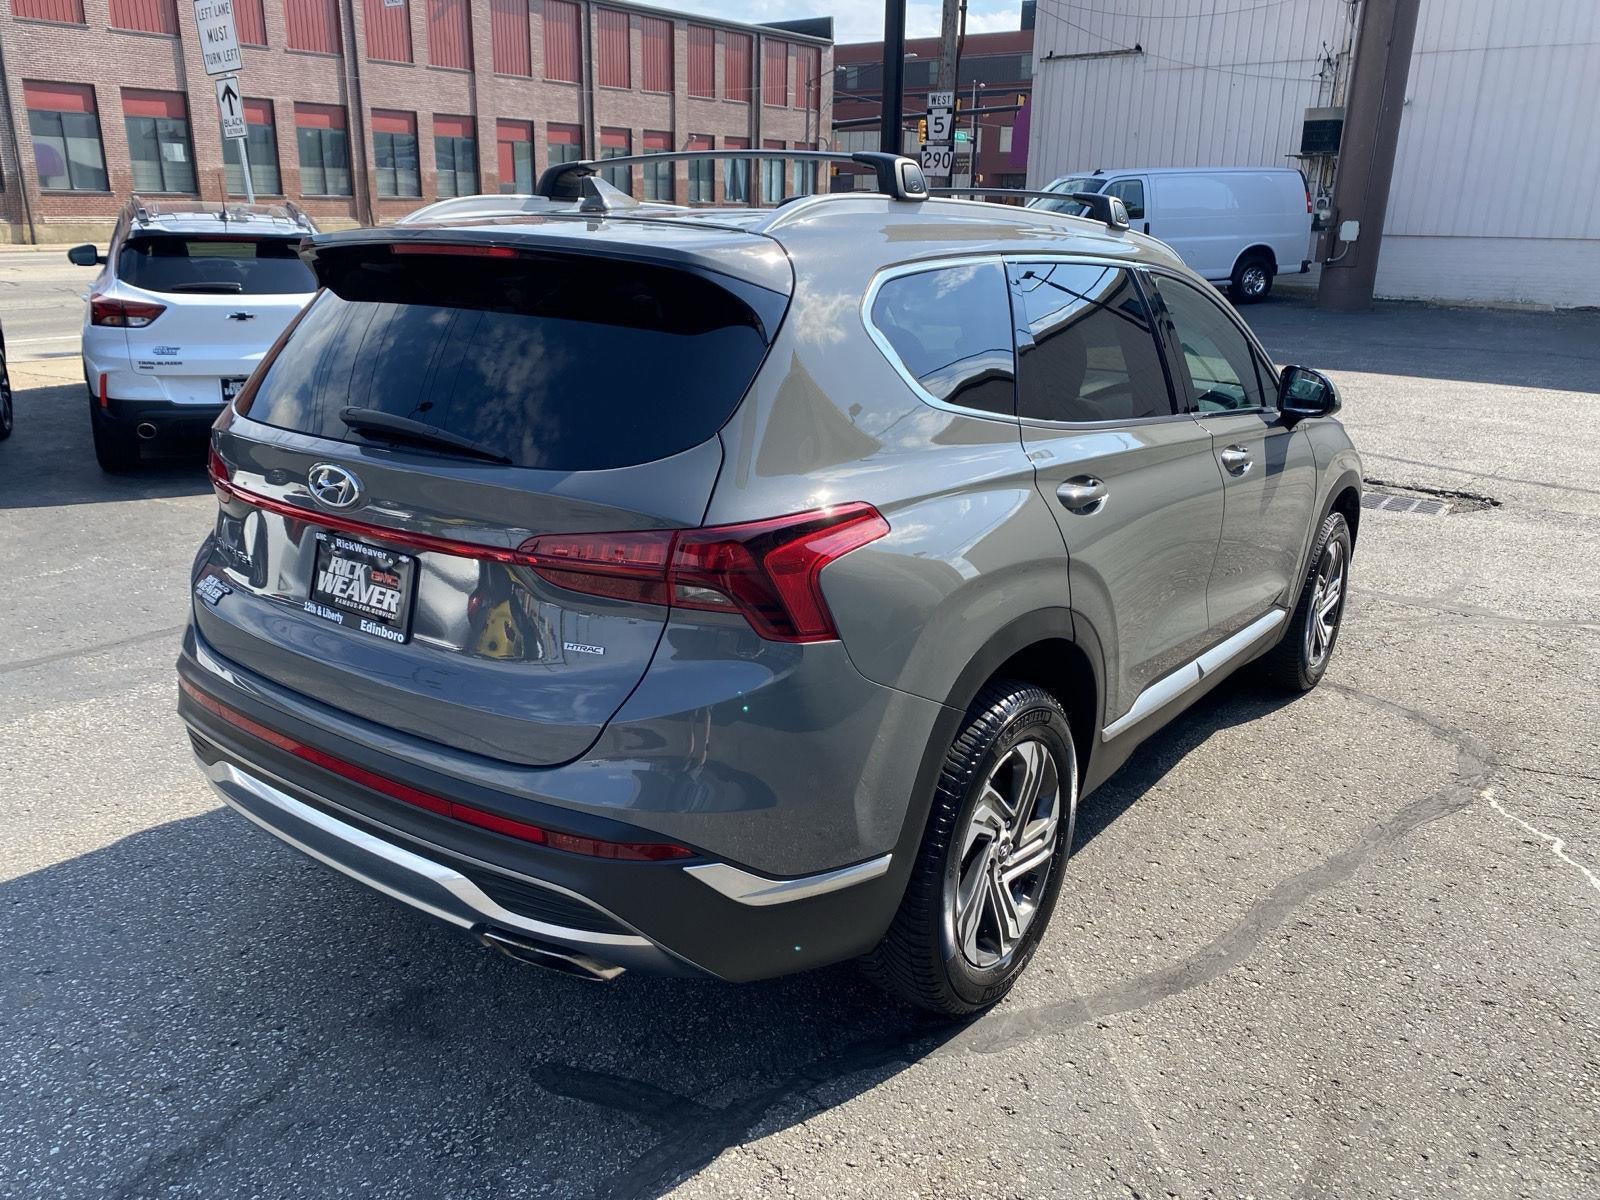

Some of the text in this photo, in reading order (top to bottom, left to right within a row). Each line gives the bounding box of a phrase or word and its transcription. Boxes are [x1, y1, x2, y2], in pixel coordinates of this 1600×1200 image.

[197, 3, 231, 20] LEFT LANE
[206, 25, 228, 42] MUST
[205, 48, 238, 65] TURN LEFT
[931, 95, 951, 105] WEST
[223, 117, 243, 128] BLACK
[933, 116, 945, 133] 5
[923, 152, 951, 169] 290
[336, 538, 387, 560] RickWeaver
[328, 555, 369, 580] RICK
[371, 570, 399, 588] GMC
[317, 570, 400, 613] WEAVER
[303, 601, 316, 614] 12th
[322, 607, 343, 624] Liberty
[360, 620, 404, 642] Edinboro
[566, 644, 602, 653] HTRAC
